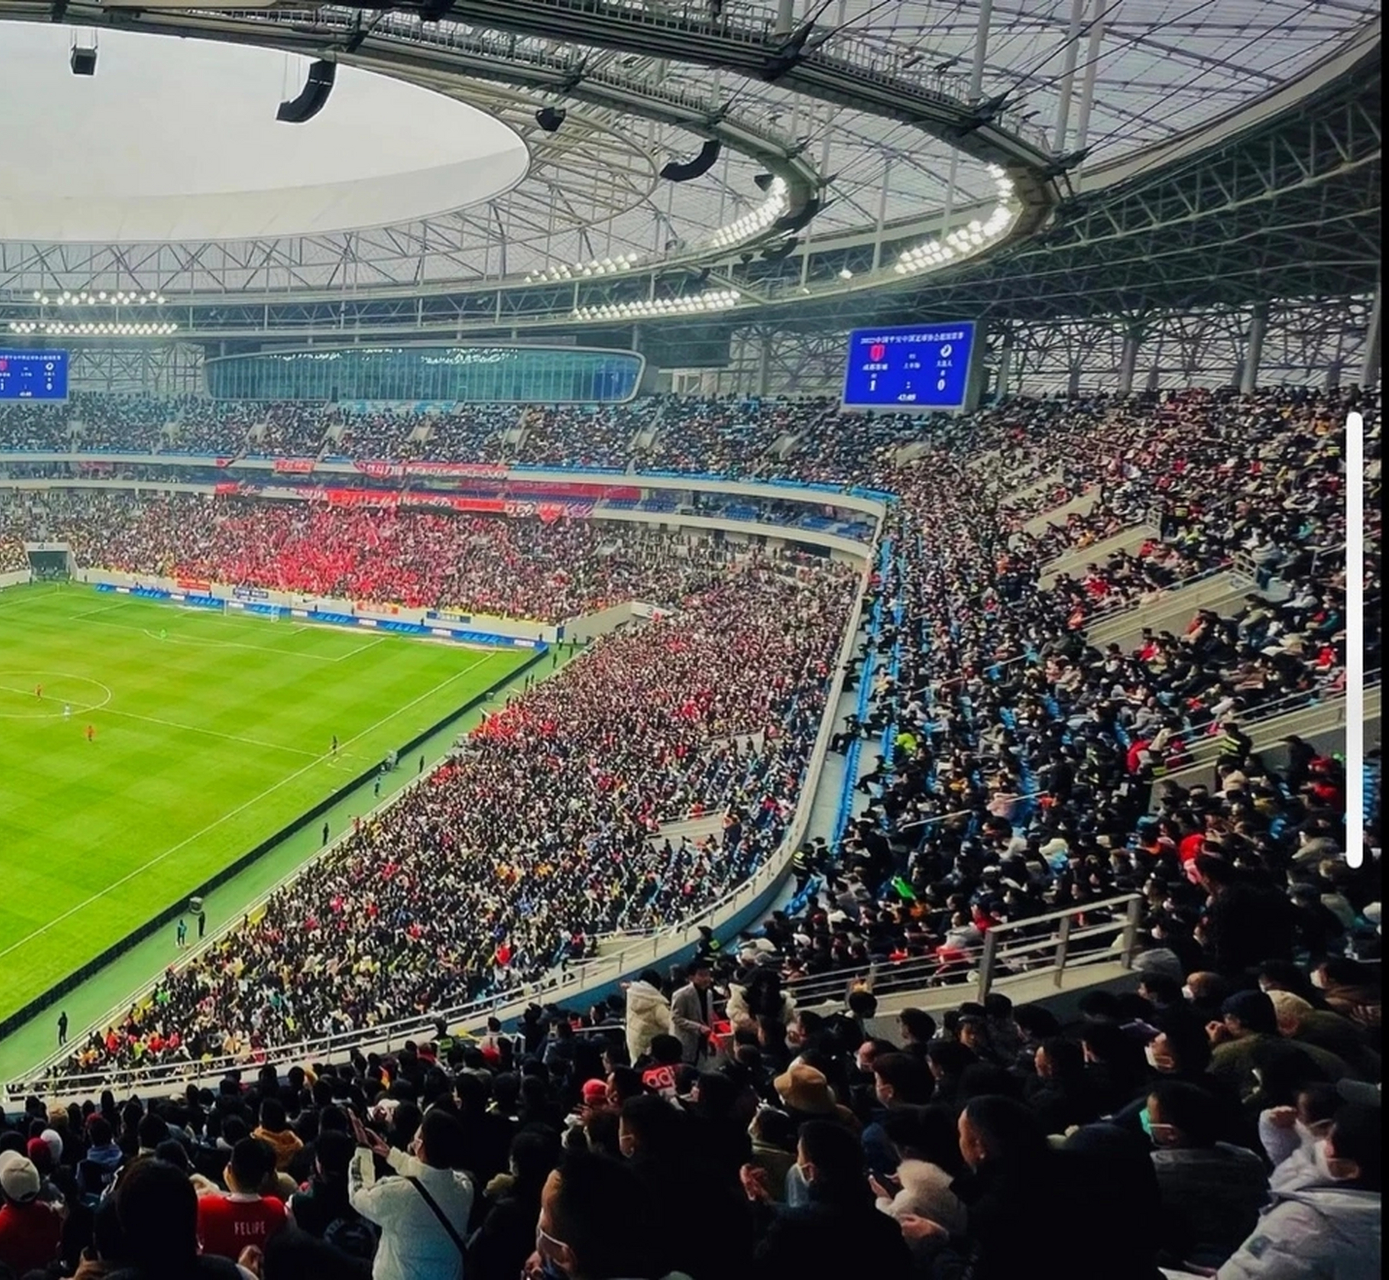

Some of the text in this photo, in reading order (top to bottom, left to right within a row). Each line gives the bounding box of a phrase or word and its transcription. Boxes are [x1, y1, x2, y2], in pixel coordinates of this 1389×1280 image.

[870, 380, 876, 391] 1
[937, 379, 945, 391] 0
[233, 1221, 266, 1236] FELIPE
